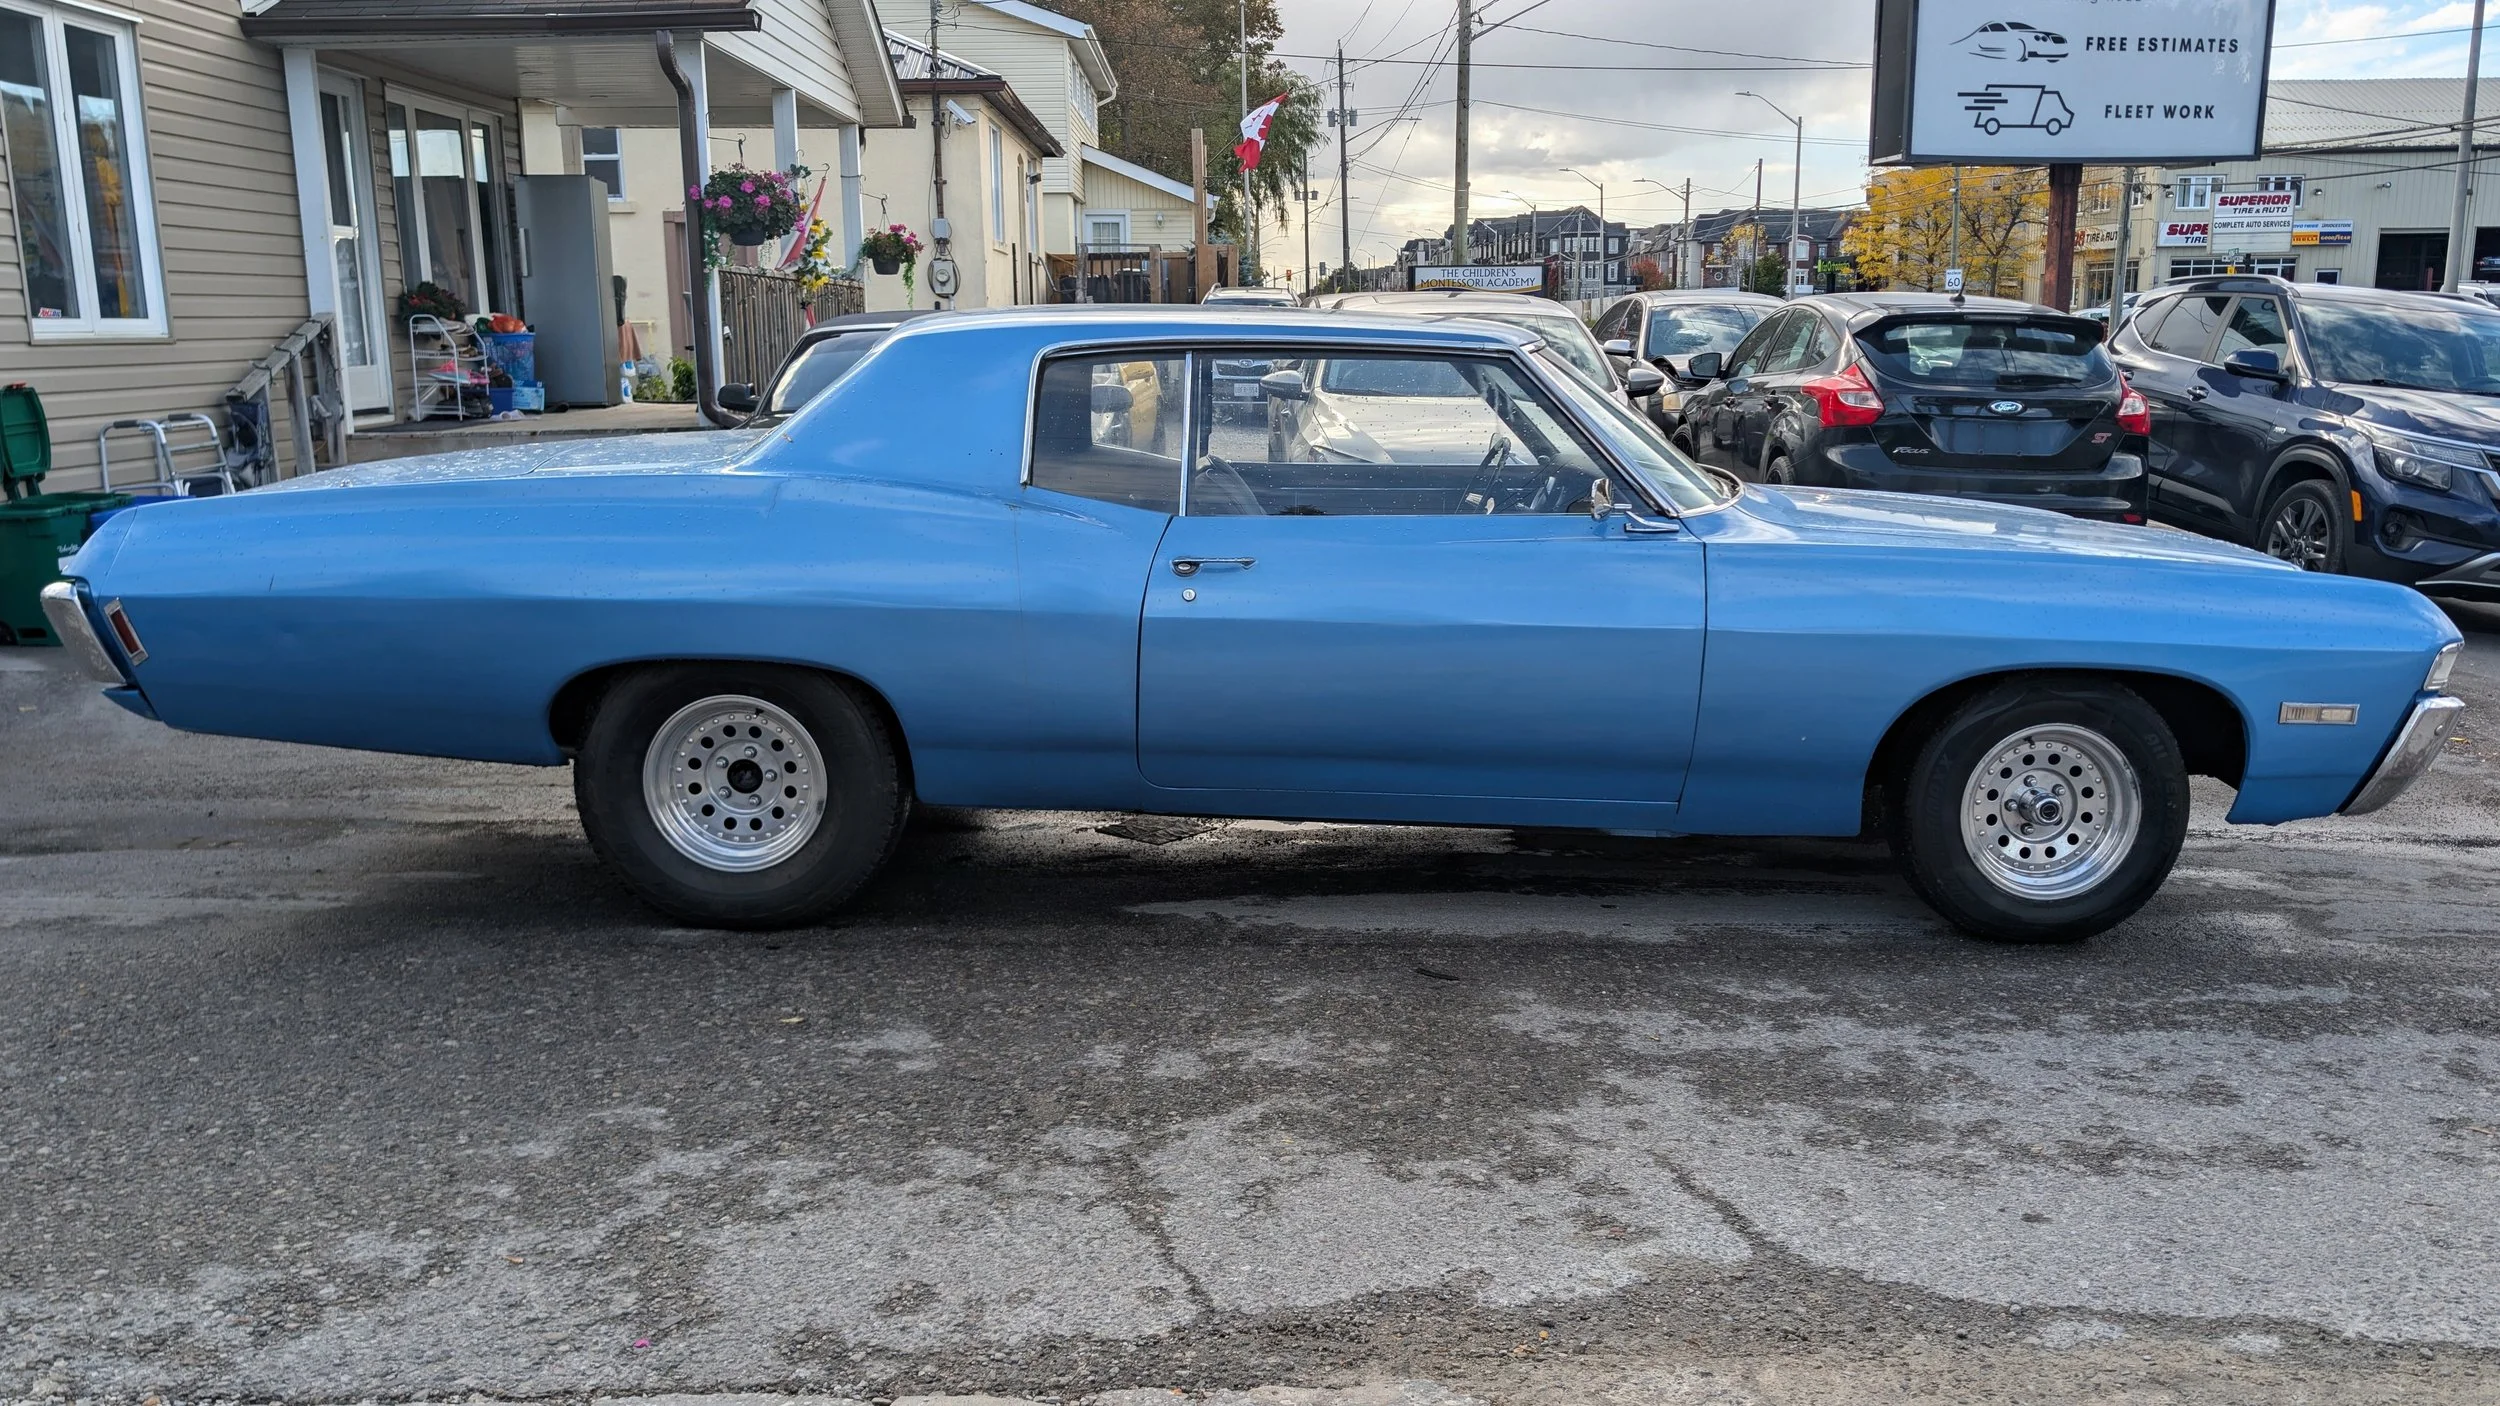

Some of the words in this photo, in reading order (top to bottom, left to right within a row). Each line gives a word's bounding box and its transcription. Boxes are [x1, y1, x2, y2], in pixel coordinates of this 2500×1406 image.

[2086, 36, 2128, 52] FREE
[2137, 37, 2239, 53] ESTIMATES
[2104, 104, 2154, 119] FLEET
[2163, 104, 2215, 119] WORK
[2218, 194, 2292, 207] SUPERIOR
[2261, 206, 2288, 214] AUTO
[2213, 221, 2244, 229] COMPLETE
[2245, 220, 2262, 229] AUTO
[2263, 219, 2291, 228] SERVICES
[2086, 232, 2100, 243] TIRE
[2185, 236, 2208, 244] TIRE
[1441, 268, 1459, 278] THE
[1462, 268, 1517, 278] CHILDREN'S
[1420, 278, 1484, 288] MONTESSORI
[1486, 277, 1536, 287] ACADEMY
[1947, 277, 1961, 287] 60
[2091, 432, 2112, 444] ST
